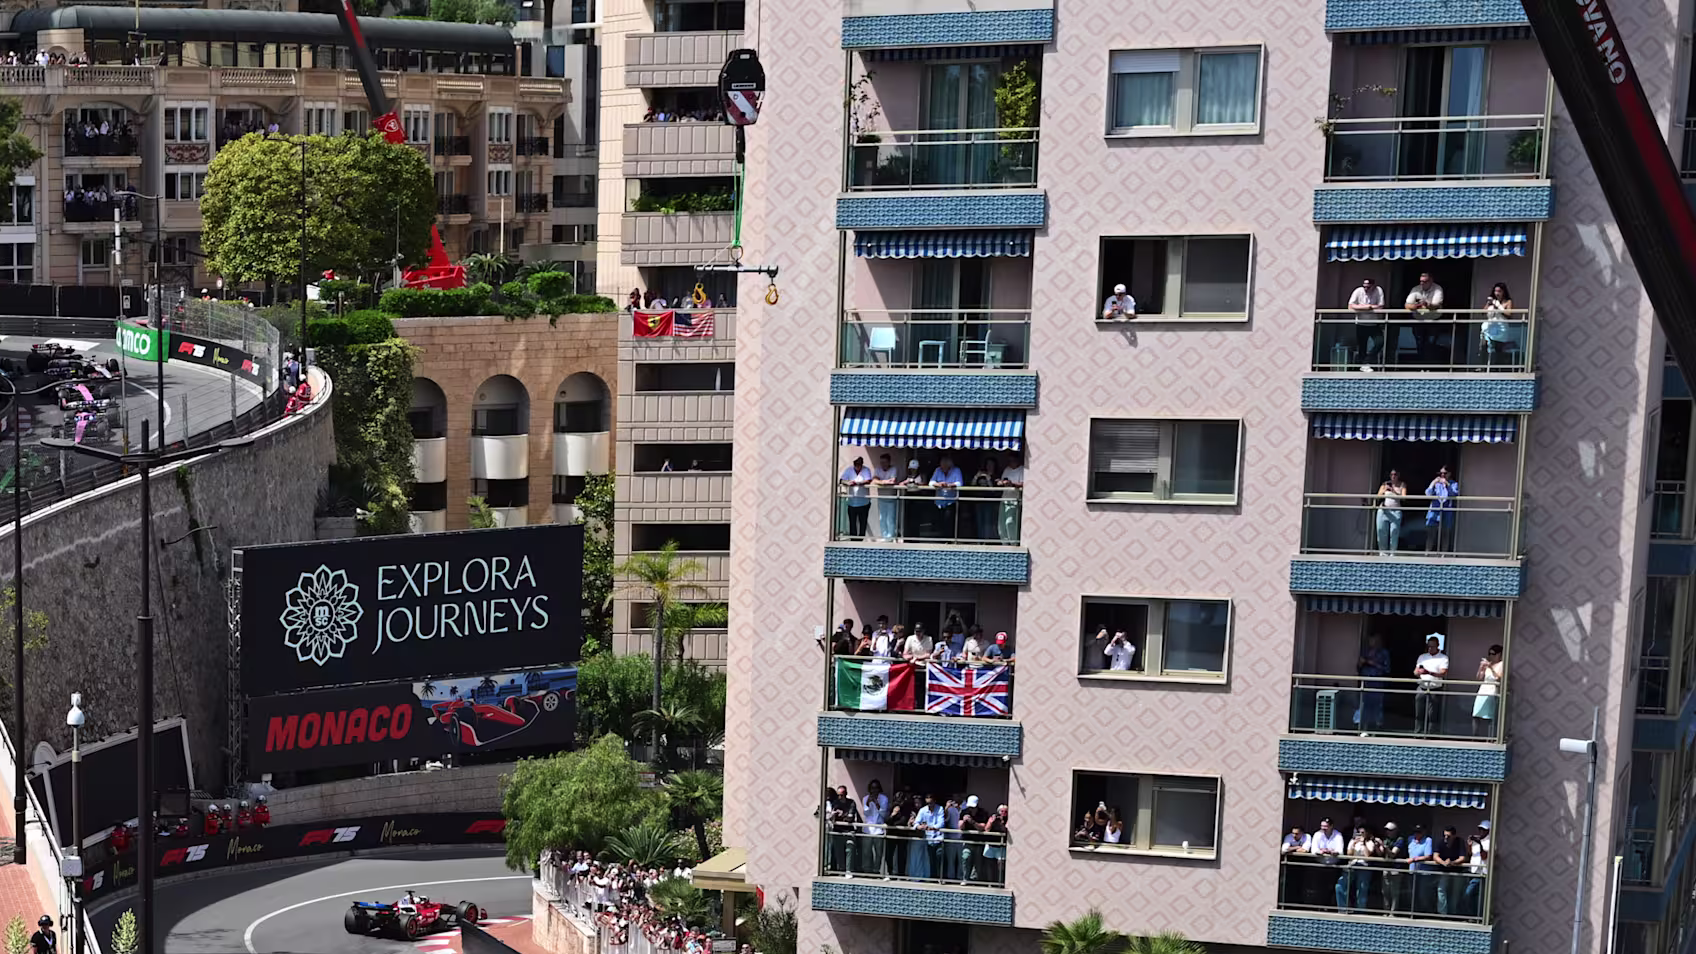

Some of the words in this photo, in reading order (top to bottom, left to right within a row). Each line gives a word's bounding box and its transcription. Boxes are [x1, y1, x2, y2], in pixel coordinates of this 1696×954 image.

[376, 554, 537, 601] EXPLORA
[371, 594, 550, 656] JOURNEYS
[265, 703, 414, 752] MONACO
